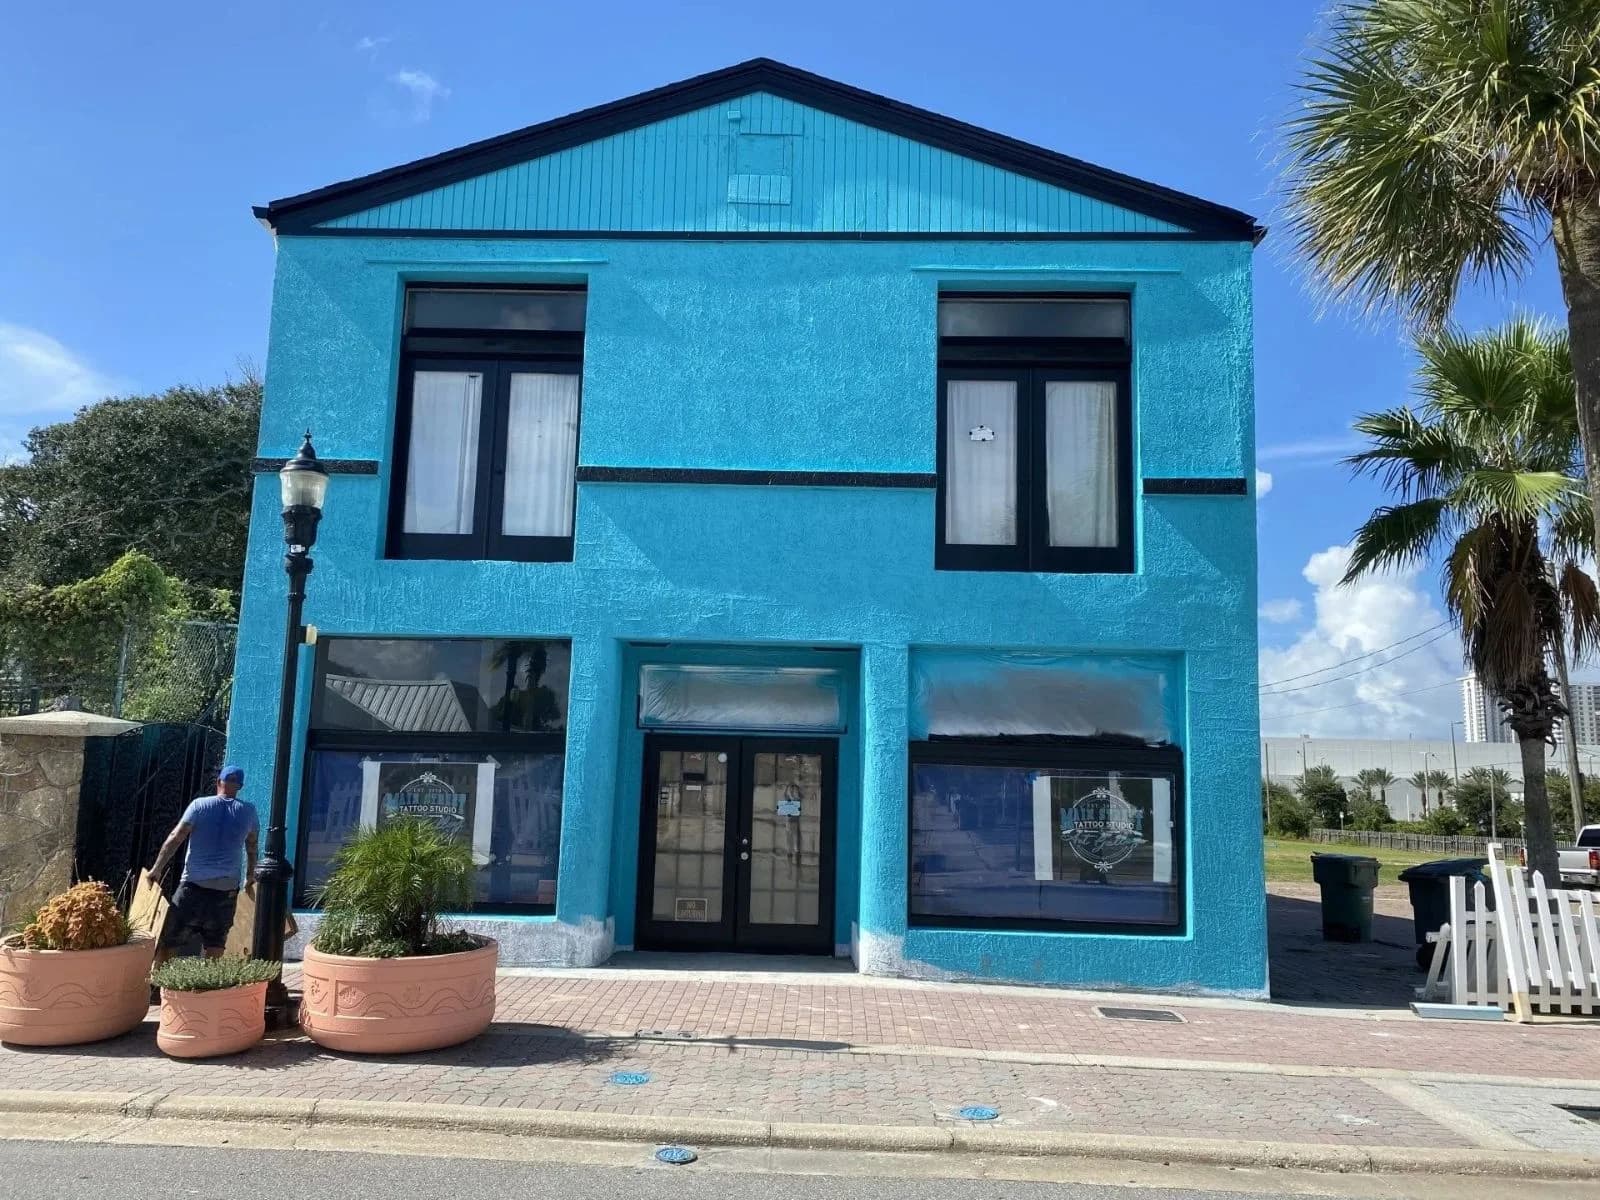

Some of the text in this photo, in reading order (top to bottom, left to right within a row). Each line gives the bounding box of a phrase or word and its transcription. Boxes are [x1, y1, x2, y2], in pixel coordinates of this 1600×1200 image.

[400, 805, 457, 814] TATTOO STUDIO
[1060, 808, 1094, 830] MAIN
[1074, 821, 1134, 830] TATTOO STUDIO
